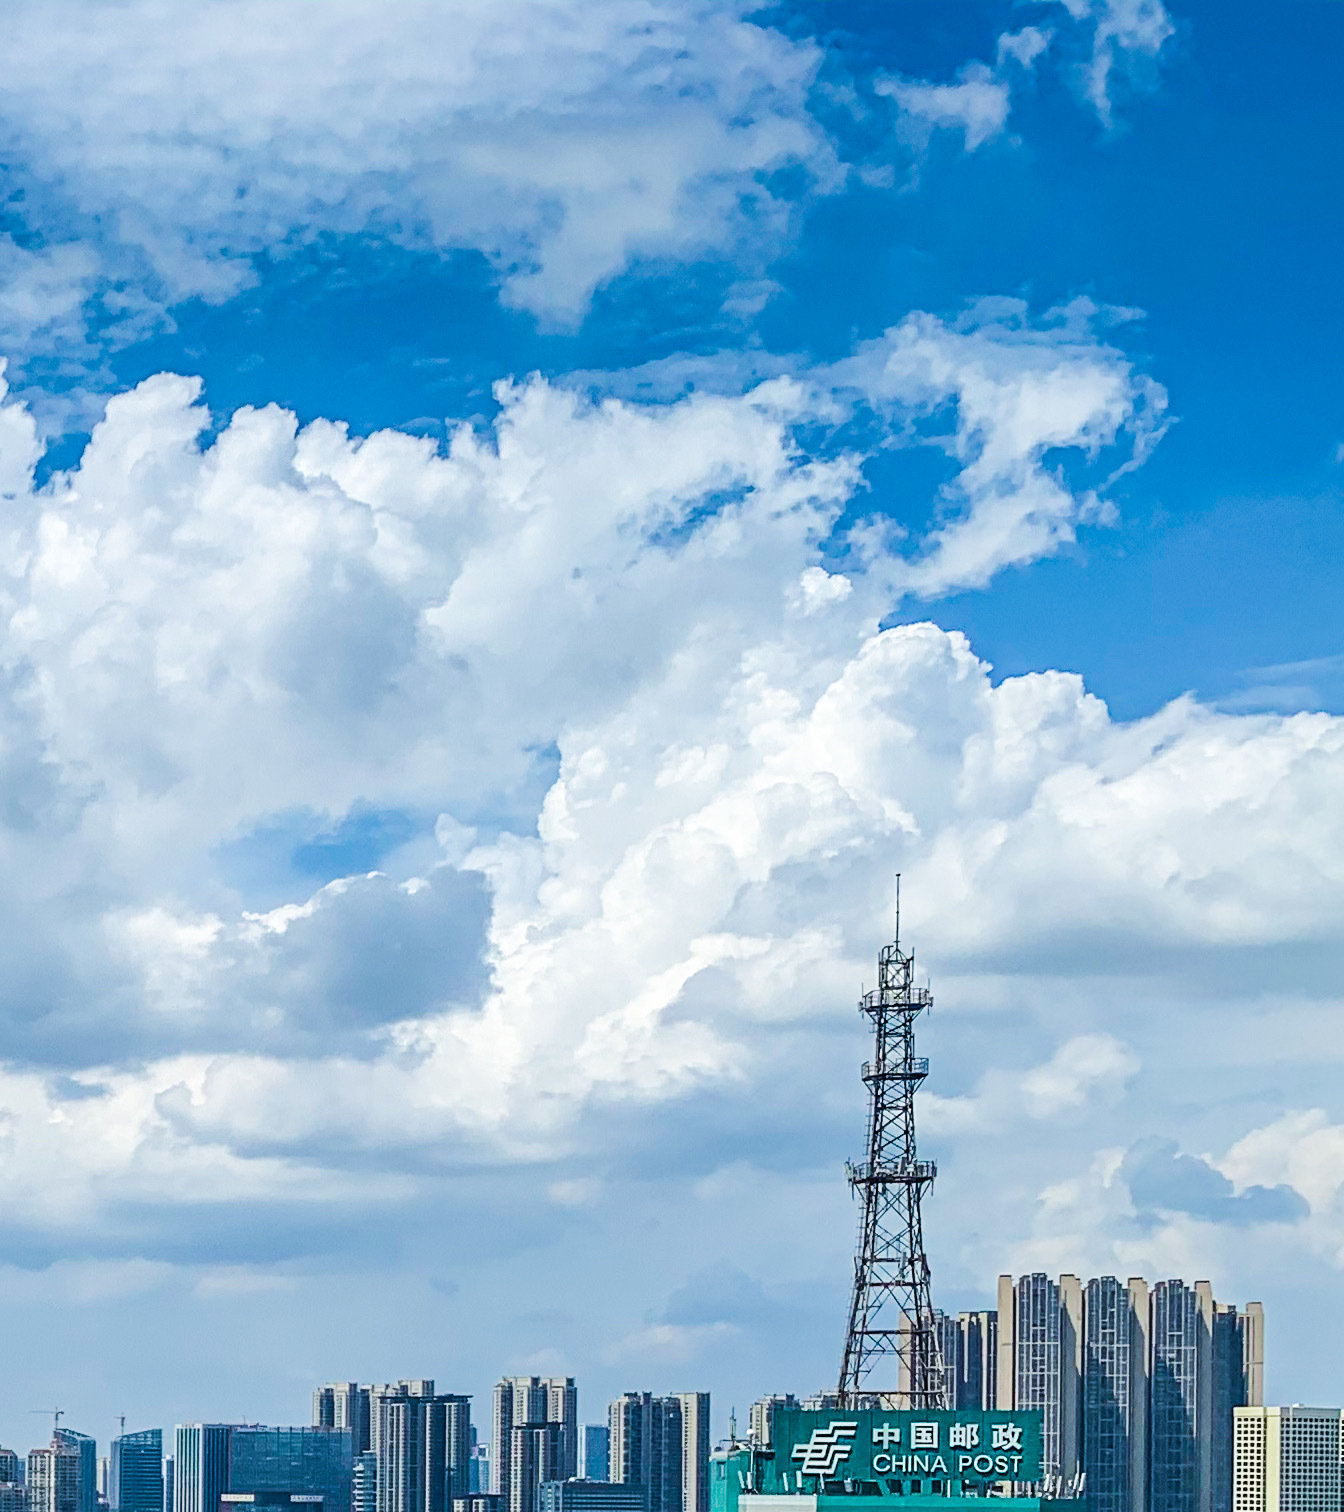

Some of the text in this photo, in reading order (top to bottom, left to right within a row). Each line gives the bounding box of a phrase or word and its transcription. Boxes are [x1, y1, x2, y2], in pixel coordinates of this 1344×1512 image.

[872, 1422, 1023, 1450] 中国邮政
[873, 1454, 1022, 1473] CHINA POST
